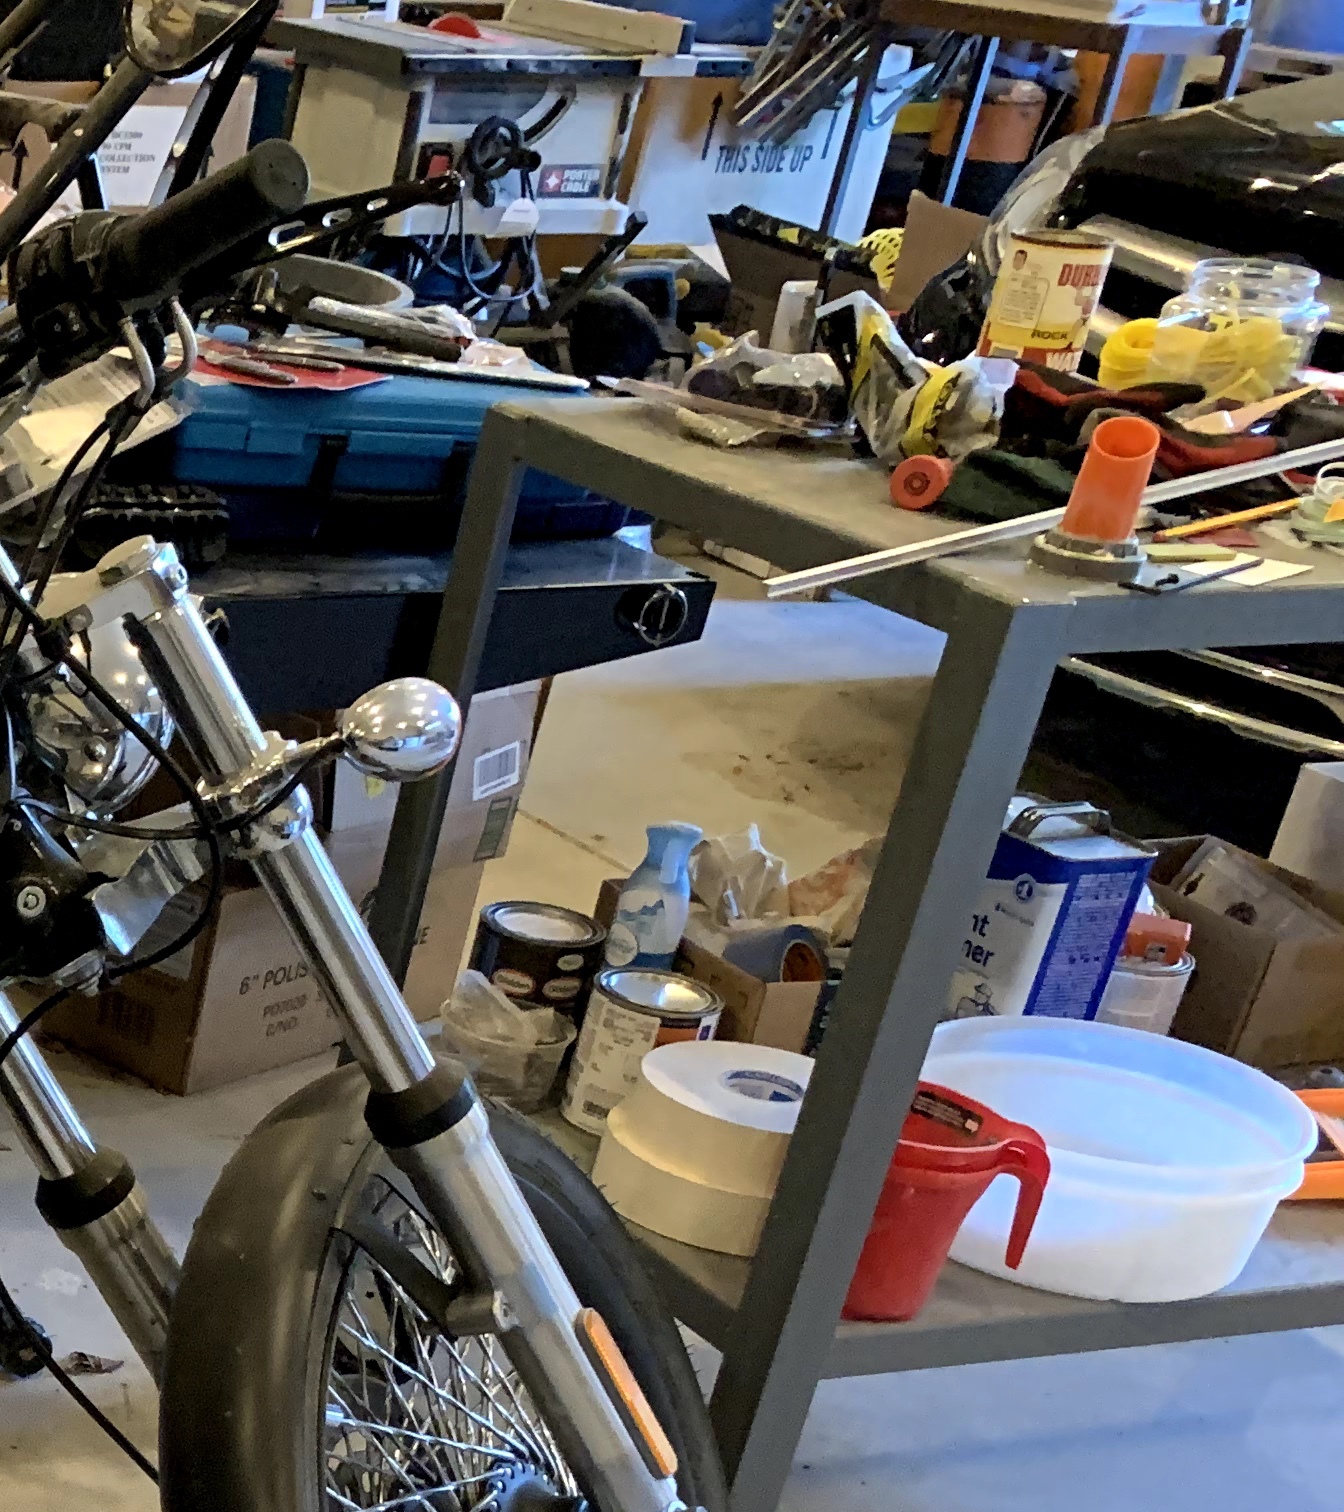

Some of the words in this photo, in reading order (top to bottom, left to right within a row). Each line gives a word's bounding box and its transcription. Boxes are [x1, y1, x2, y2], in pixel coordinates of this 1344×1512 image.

[715, 145, 748, 174] THIS
[751, 145, 786, 173] SIDE
[789, 144, 813, 173] UP
[100, 165, 130, 174] YSTEM
[562, 169, 600, 180] PORTER
[560, 182, 590, 193] CABLE
[1031, 330, 1068, 340] ROCK
